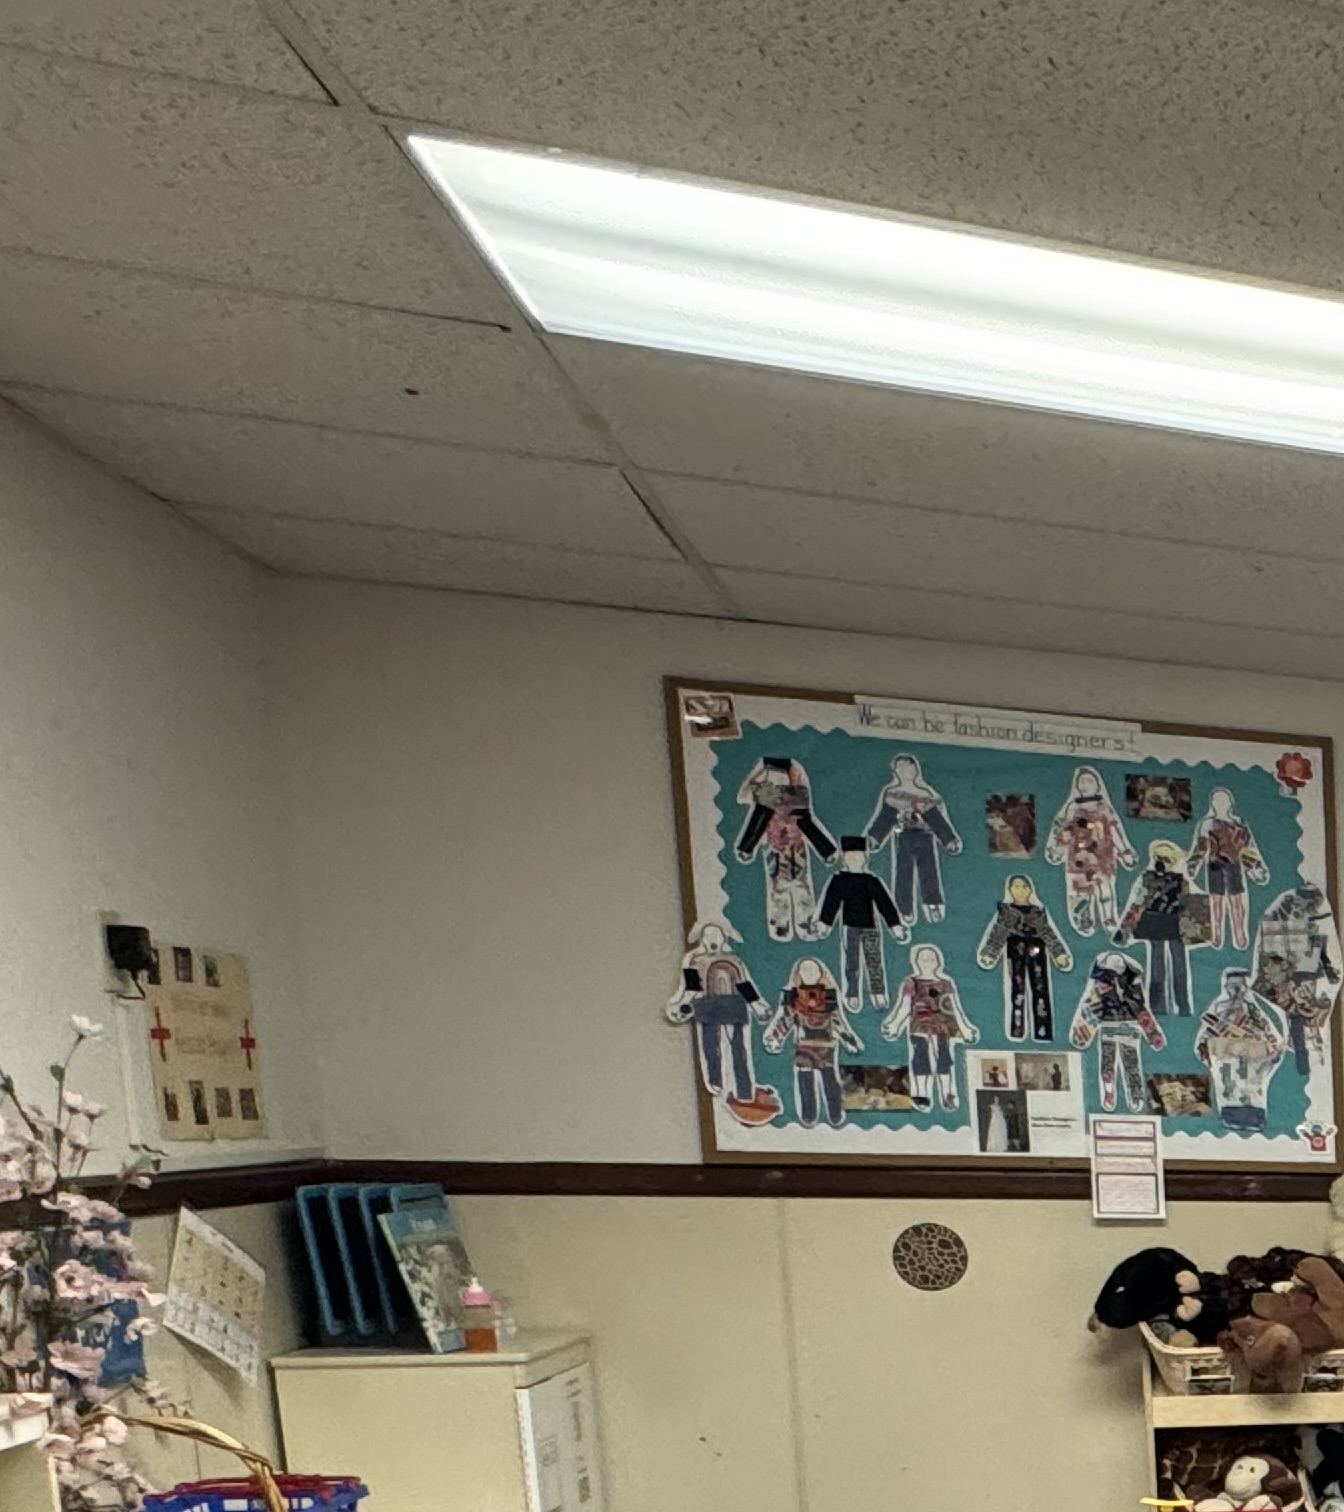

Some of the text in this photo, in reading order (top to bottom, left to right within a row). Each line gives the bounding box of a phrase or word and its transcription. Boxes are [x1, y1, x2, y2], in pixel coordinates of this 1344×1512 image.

[858, 703, 880, 727] We
[887, 716, 916, 730] can
[922, 712, 944, 734] be
[952, 713, 1021, 742] fashion
